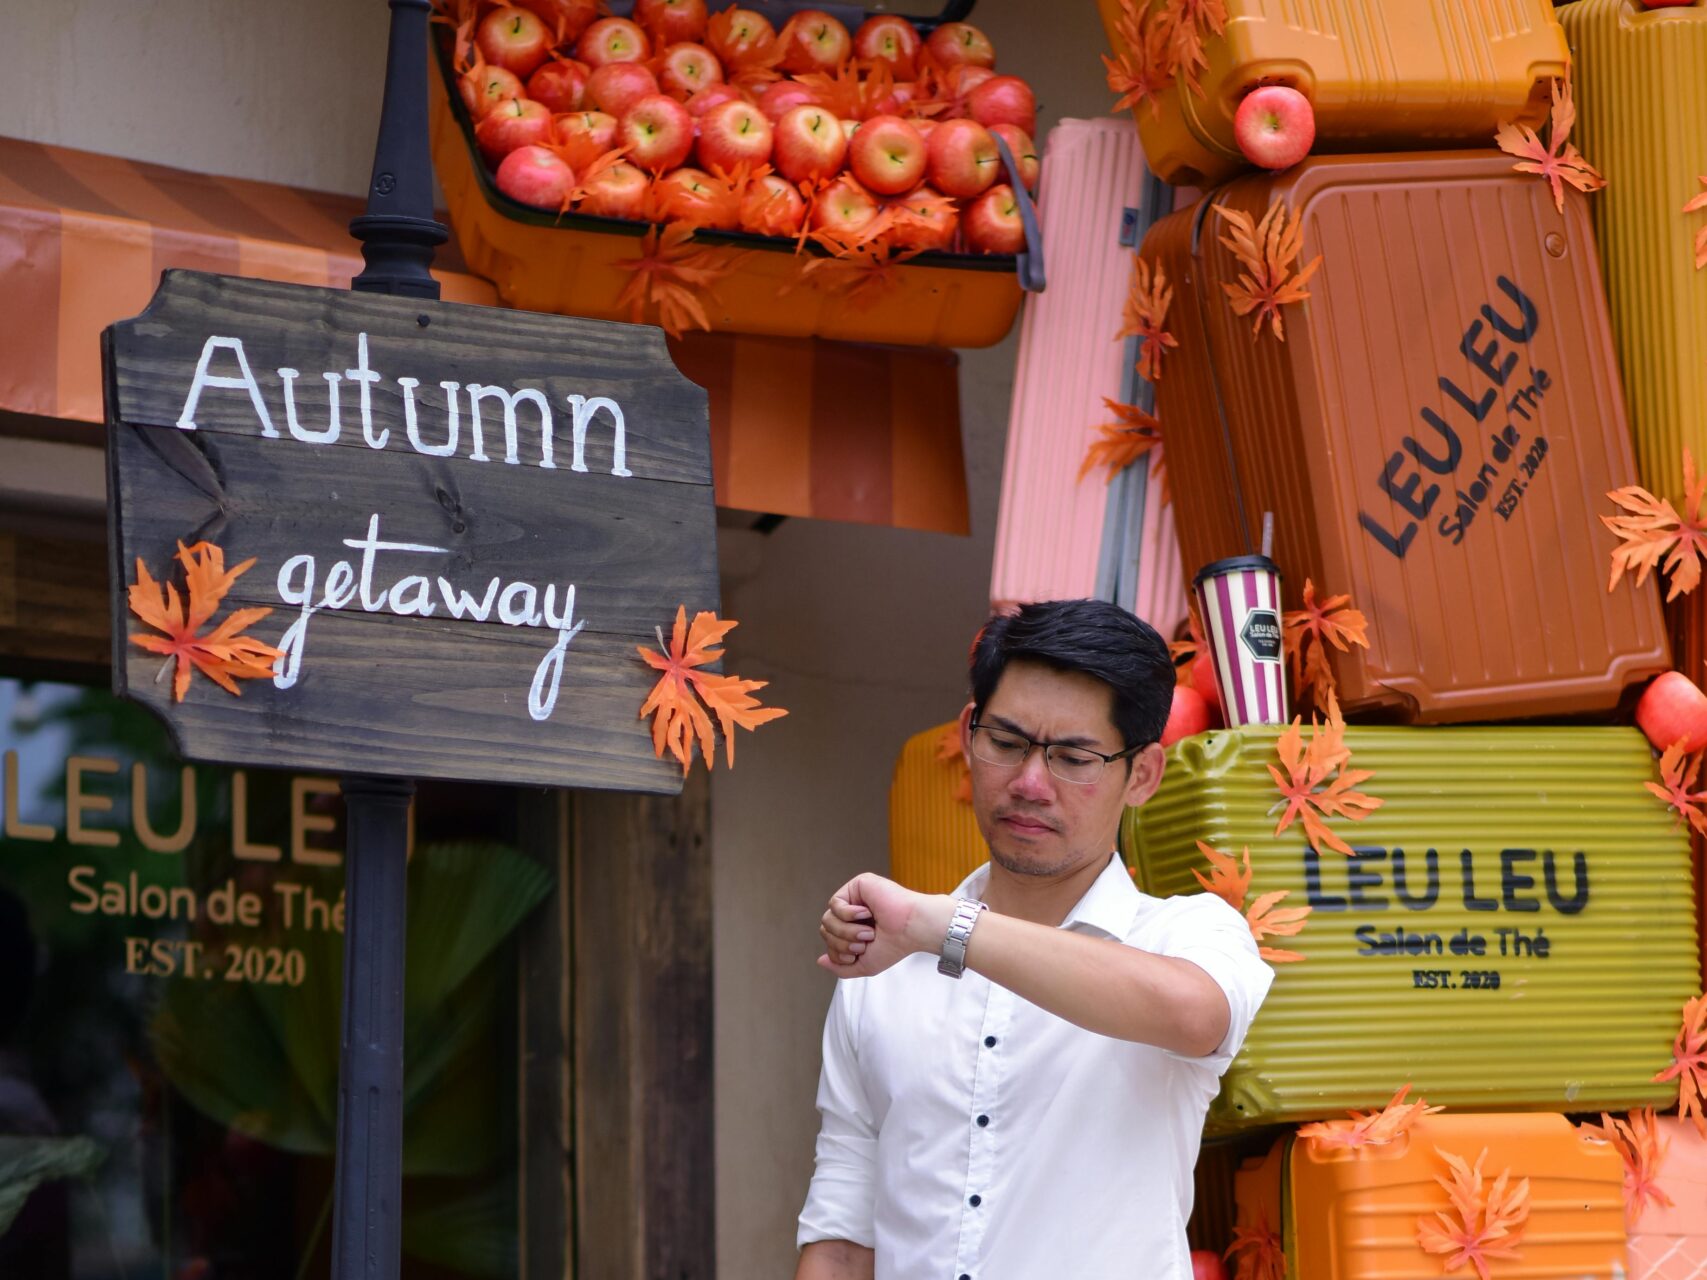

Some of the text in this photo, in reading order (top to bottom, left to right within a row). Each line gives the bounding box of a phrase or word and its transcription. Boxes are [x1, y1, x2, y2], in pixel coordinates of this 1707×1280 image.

[175, 331, 633, 478] Autumn
[1358, 275, 1540, 560] LEU LEU
[1438, 462, 1500, 546] Salon
[1494, 478, 1529, 522] EST.
[272, 513, 590, 722] getaway
[1249, 623, 1266, 633] LEU
[4, 750, 415, 866] LEU LE
[68, 865, 197, 921] Salon
[206, 879, 262, 927] de
[1303, 846, 1590, 914] LEU LEU
[125, 937, 306, 985] EST. 2020
[1355, 924, 1552, 958] Salon de Thé
[1412, 969, 1457, 989] EST.
